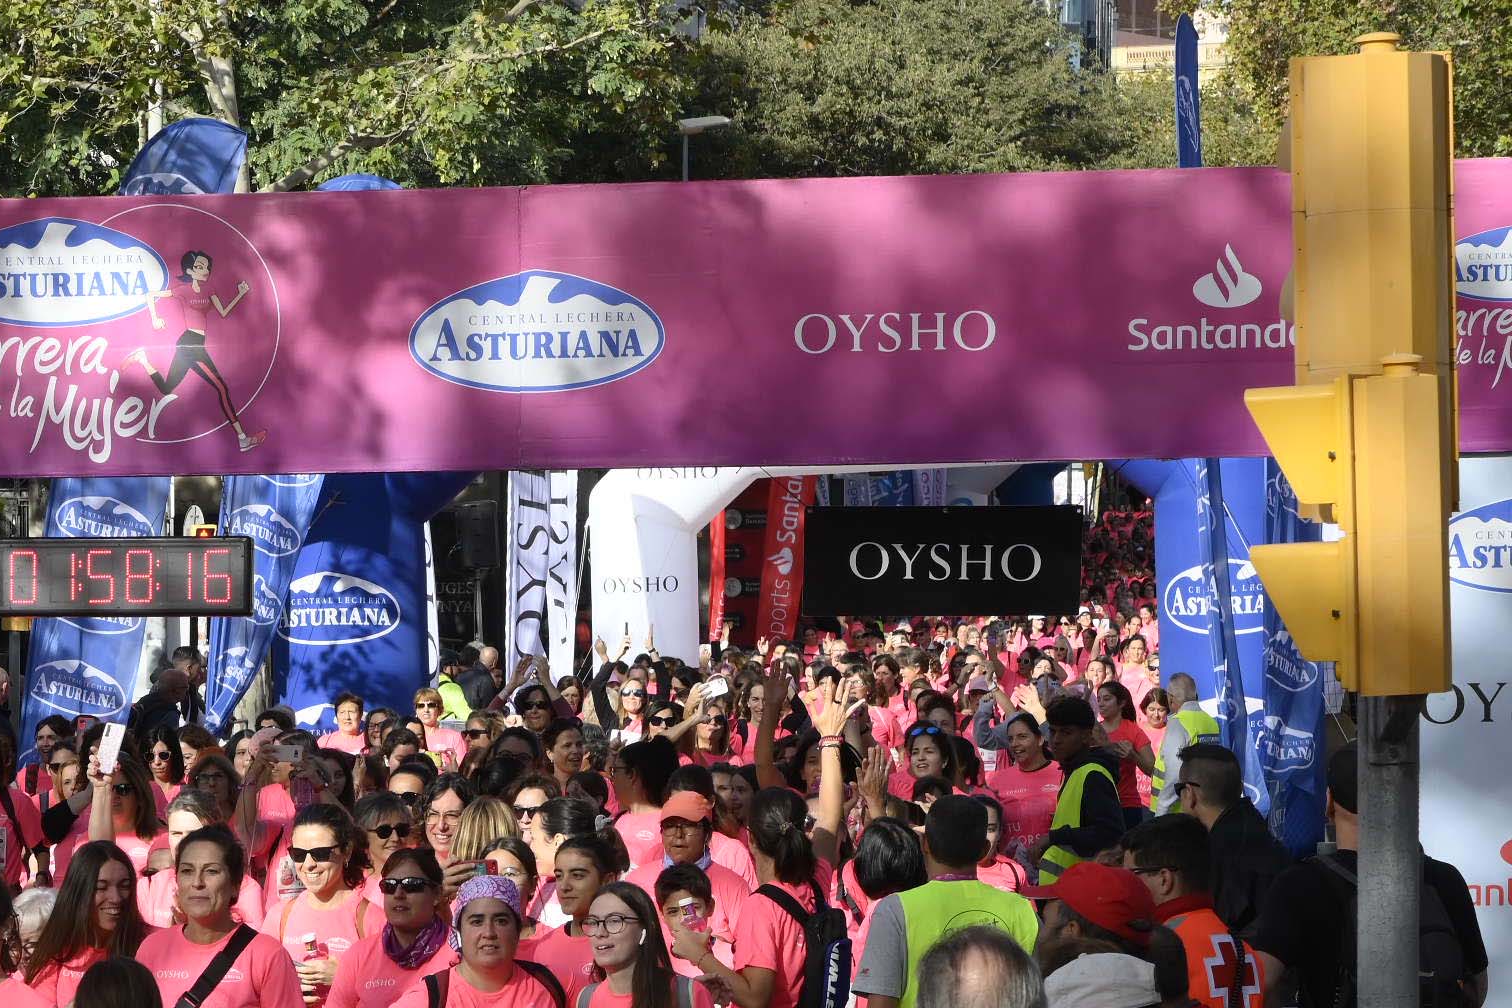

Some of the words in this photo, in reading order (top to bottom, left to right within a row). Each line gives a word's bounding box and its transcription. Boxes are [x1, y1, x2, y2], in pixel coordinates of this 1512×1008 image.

[468, 312, 547, 327] CENTRAL
[555, 311, 636, 324] LECHERA
[794, 310, 997, 354] OYSHO
[428, 318, 645, 362] ASTURIANA
[9, 377, 34, 417] la
[29, 369, 179, 463] Mujer
[849, 541, 1041, 582] OYSHO
[603, 575, 679, 594] OYSHO
[279, 608, 391, 629] ASTURIANA
[34, 672, 117, 710] ASTURIANA
